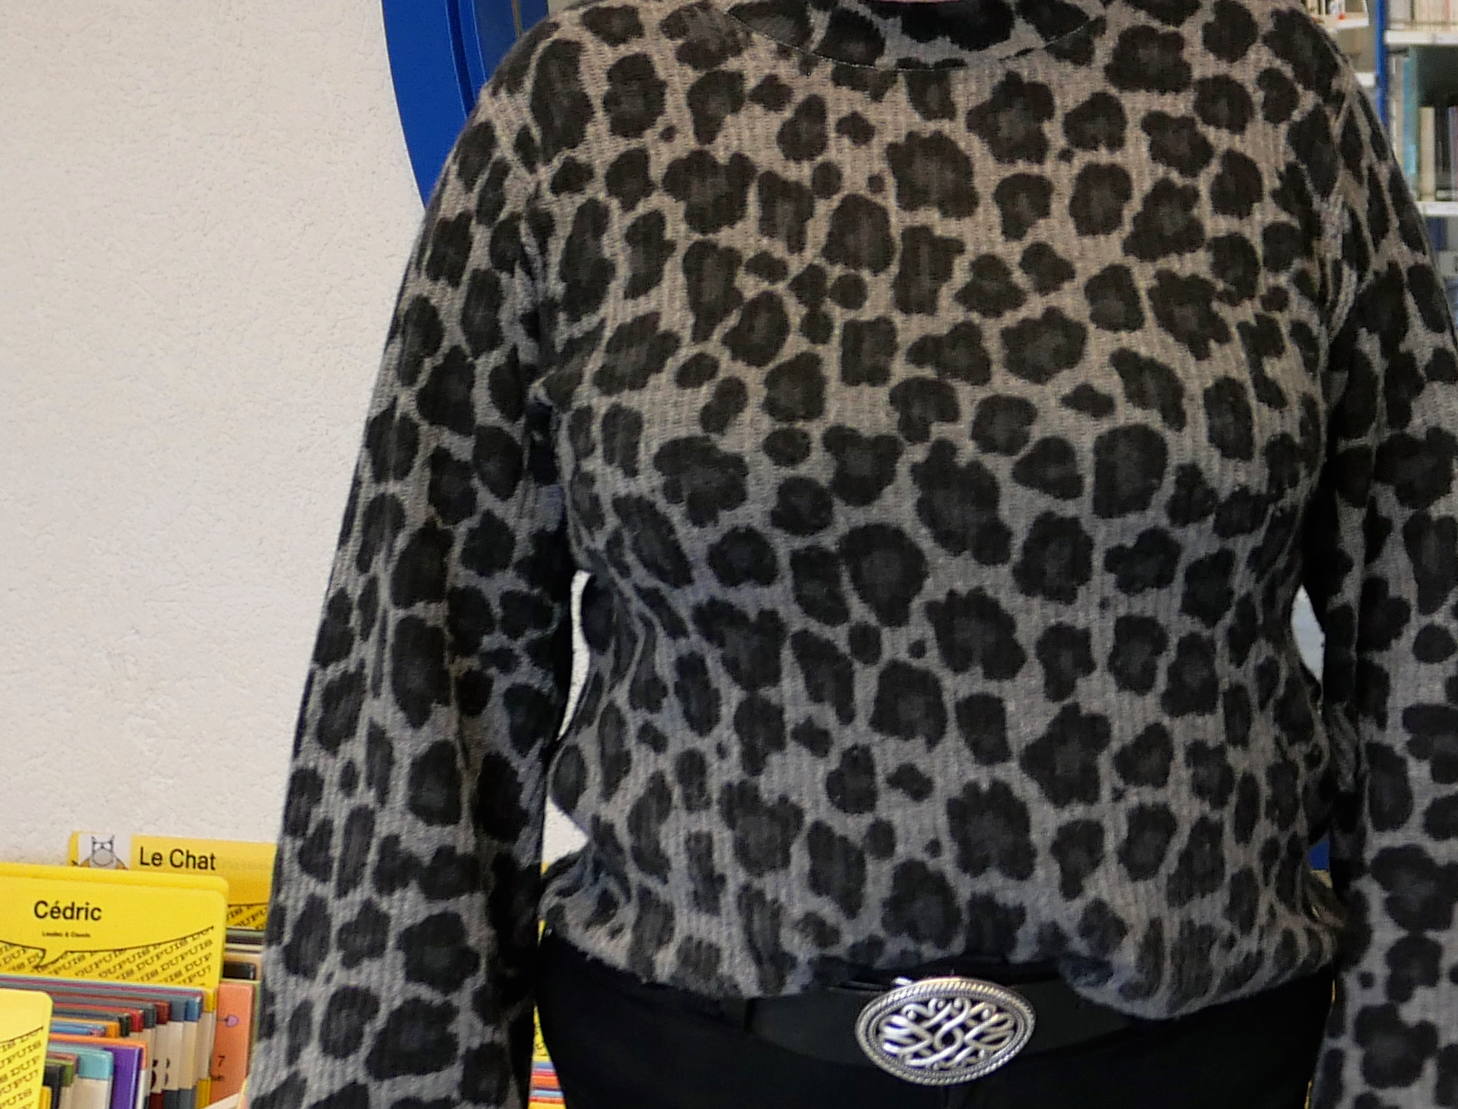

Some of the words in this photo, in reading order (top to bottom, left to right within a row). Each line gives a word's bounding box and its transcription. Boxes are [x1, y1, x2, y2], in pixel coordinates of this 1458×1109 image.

[139, 846, 163, 866] Le
[169, 848, 216, 870] Chat
[34, 899, 102, 921] Cédric
[217, 1055, 226, 1068] 7
